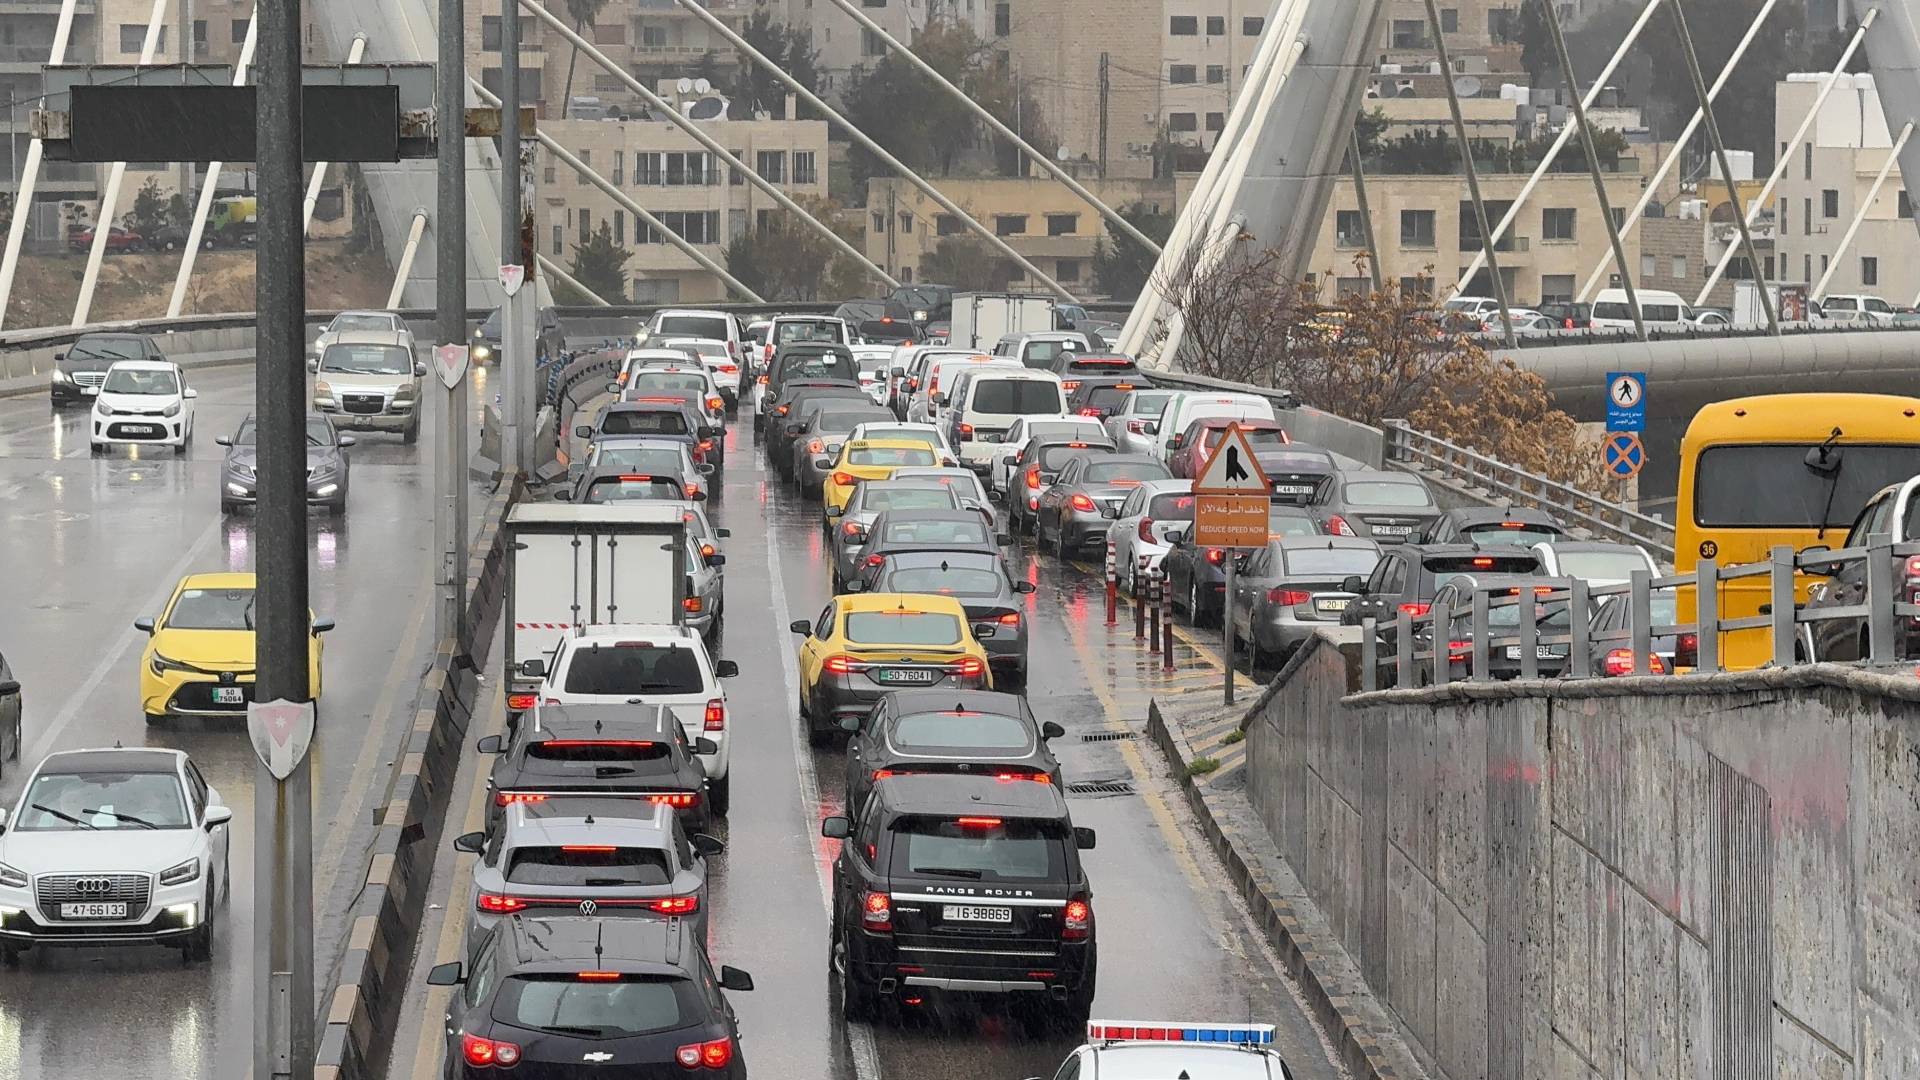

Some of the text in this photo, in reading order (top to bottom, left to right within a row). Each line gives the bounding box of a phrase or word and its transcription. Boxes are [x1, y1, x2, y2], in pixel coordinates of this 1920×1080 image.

[1200, 525, 1265, 534] REDUCE SPEED NOW
[1702, 543, 1715, 556] 36
[889, 671, 930, 680] 50-76041
[926, 886, 1033, 897] RANGE ROVER
[72, 904, 125, 915] 47-66133
[956, 907, 1010, 920] 16-98869
